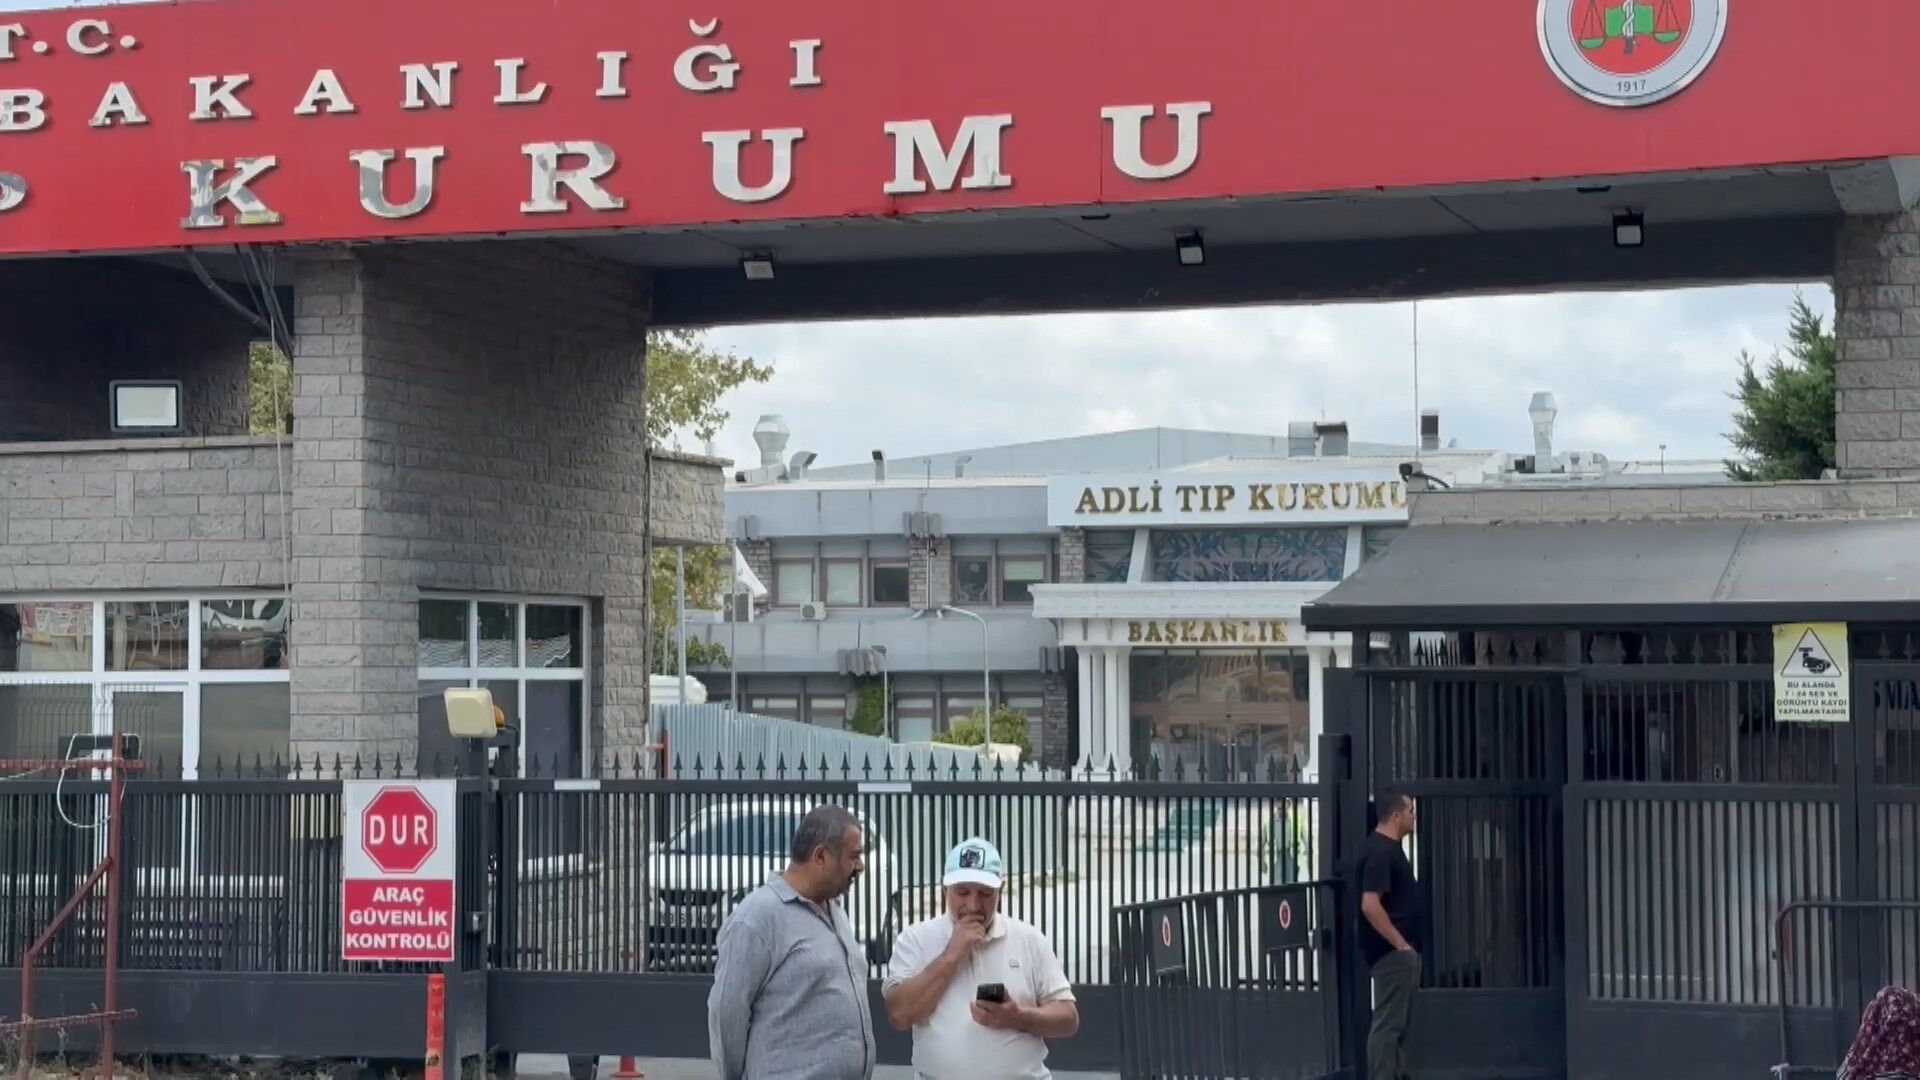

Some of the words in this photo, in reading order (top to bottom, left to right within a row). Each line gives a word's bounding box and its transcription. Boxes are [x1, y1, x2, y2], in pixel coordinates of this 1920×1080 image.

[1616, 79, 1646, 92] 1917
[180, 101, 1212, 229] KURUMU
[1075, 480, 1163, 513] ADLİ
[1175, 484, 1236, 512] TIP
[1248, 481, 1408, 511] KURUMU
[1128, 620, 1288, 644] BAŞKANLIK
[369, 815, 429, 846] DUR
[372, 887, 425, 906] ARAÇ
[349, 907, 448, 926] GÜVENLİK
[346, 932, 450, 949] KONTROLÜ
